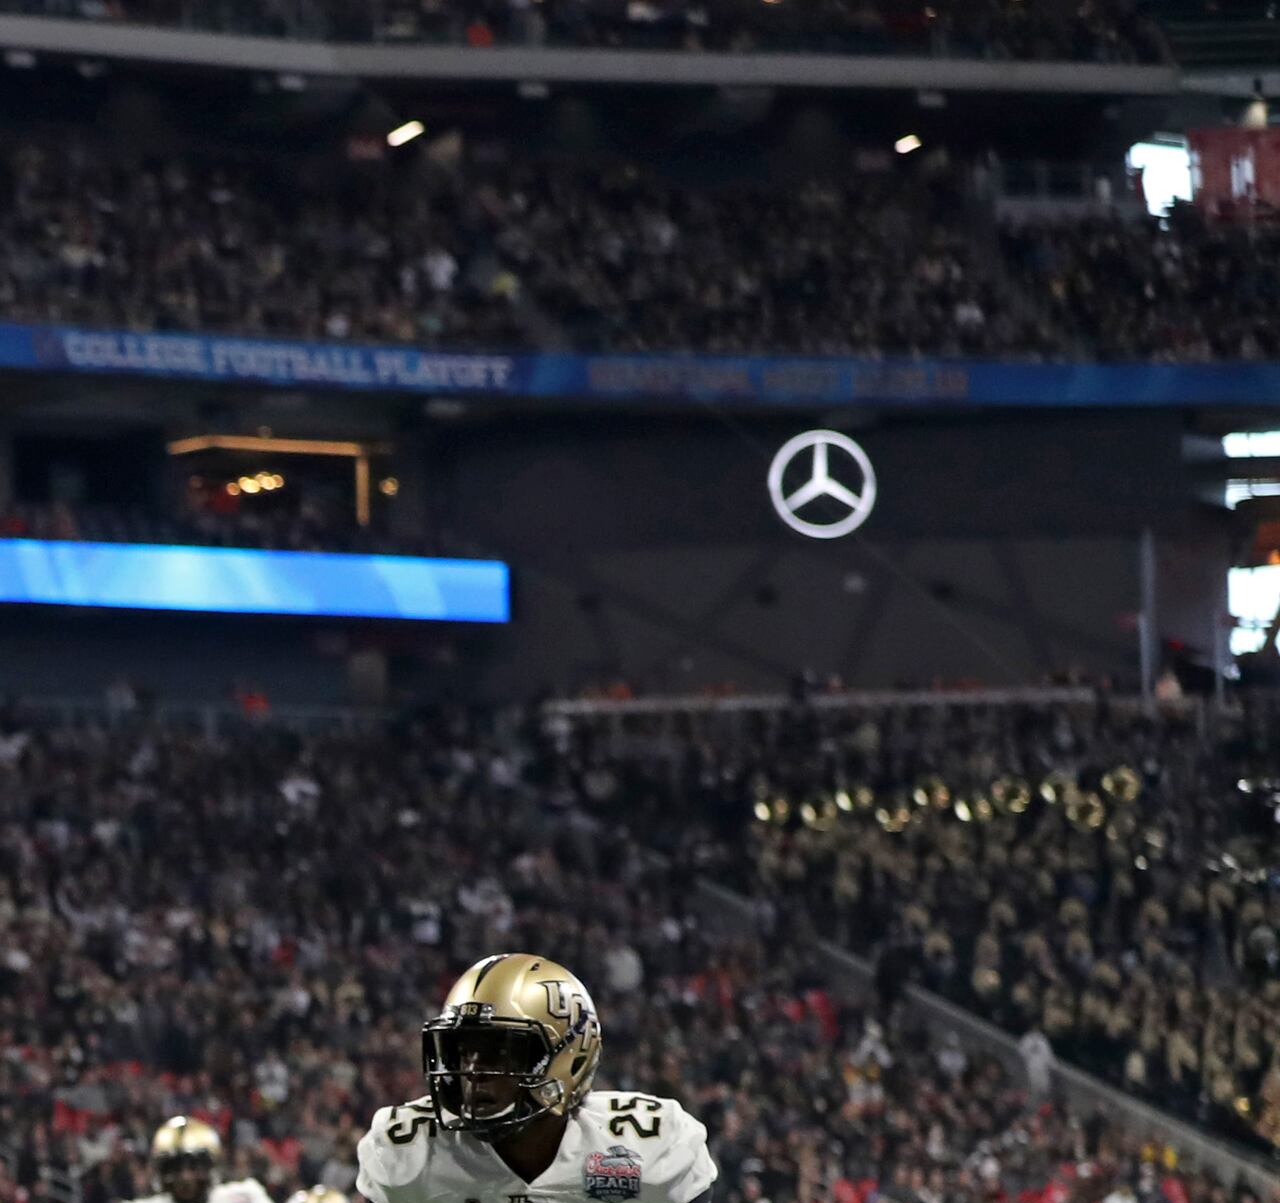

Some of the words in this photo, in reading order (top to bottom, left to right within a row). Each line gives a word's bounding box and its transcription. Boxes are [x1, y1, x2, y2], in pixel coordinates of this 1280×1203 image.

[63, 330, 209, 373] COLLEGE
[211, 339, 374, 384] FOOTBALL
[375, 349, 513, 388] PLAYOFF
[609, 1096, 662, 1138] 25
[586, 1175, 639, 1191] PEACH
